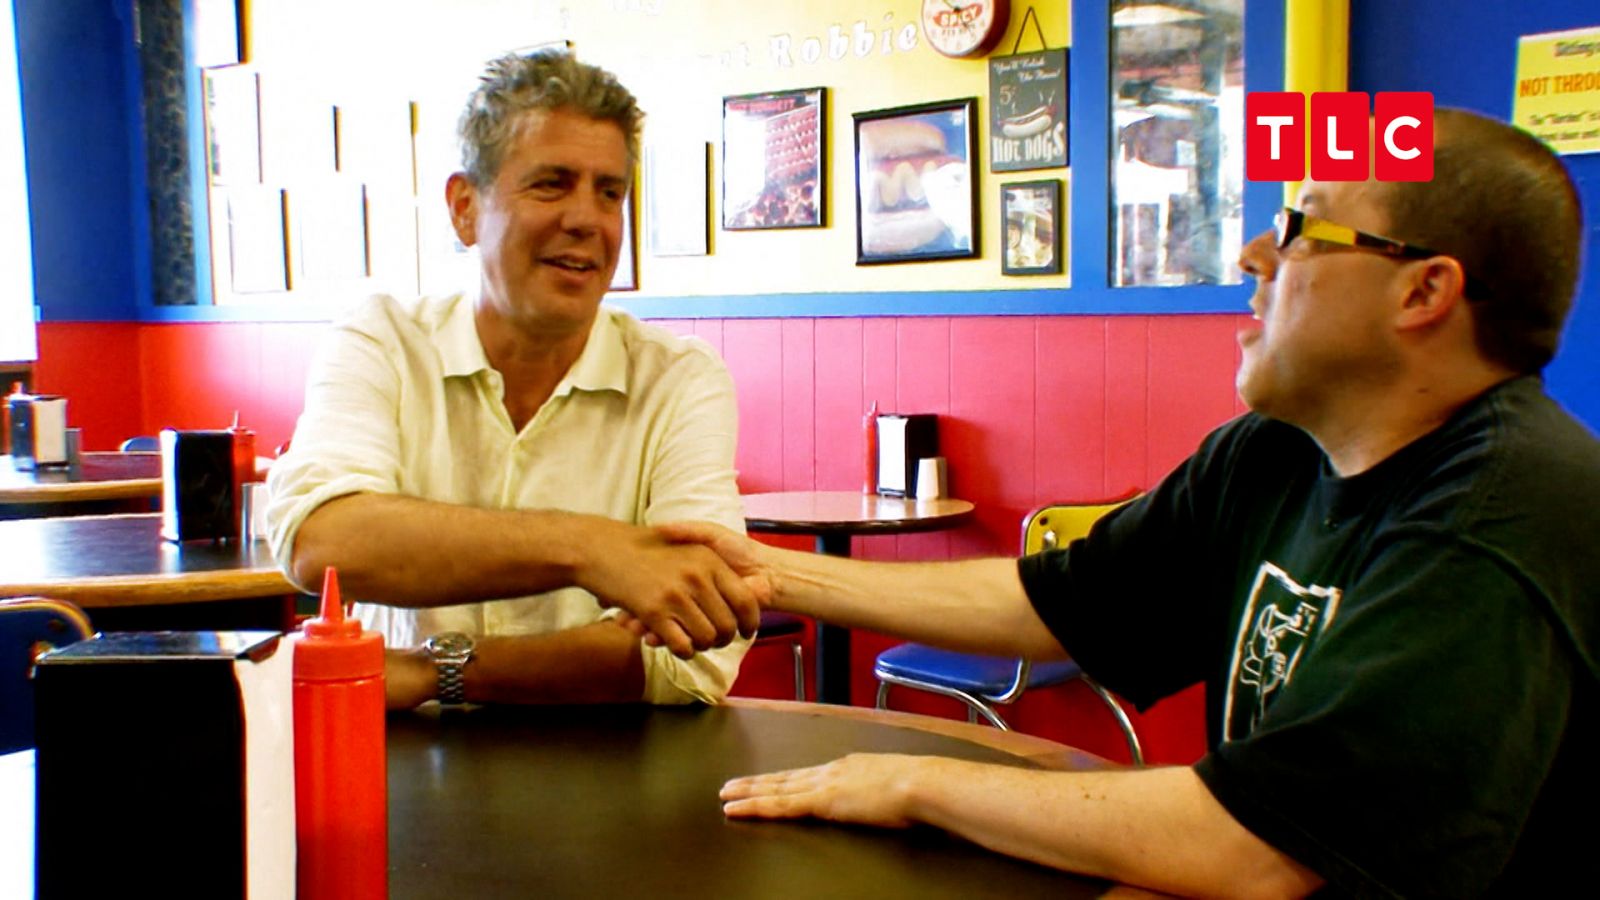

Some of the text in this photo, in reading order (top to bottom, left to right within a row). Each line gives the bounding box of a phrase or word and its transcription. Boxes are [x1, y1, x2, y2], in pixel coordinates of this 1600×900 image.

[768, 11, 919, 68] Robbie
[1520, 76, 1549, 97] NOT
[992, 121, 1064, 163] HOT DOGS
